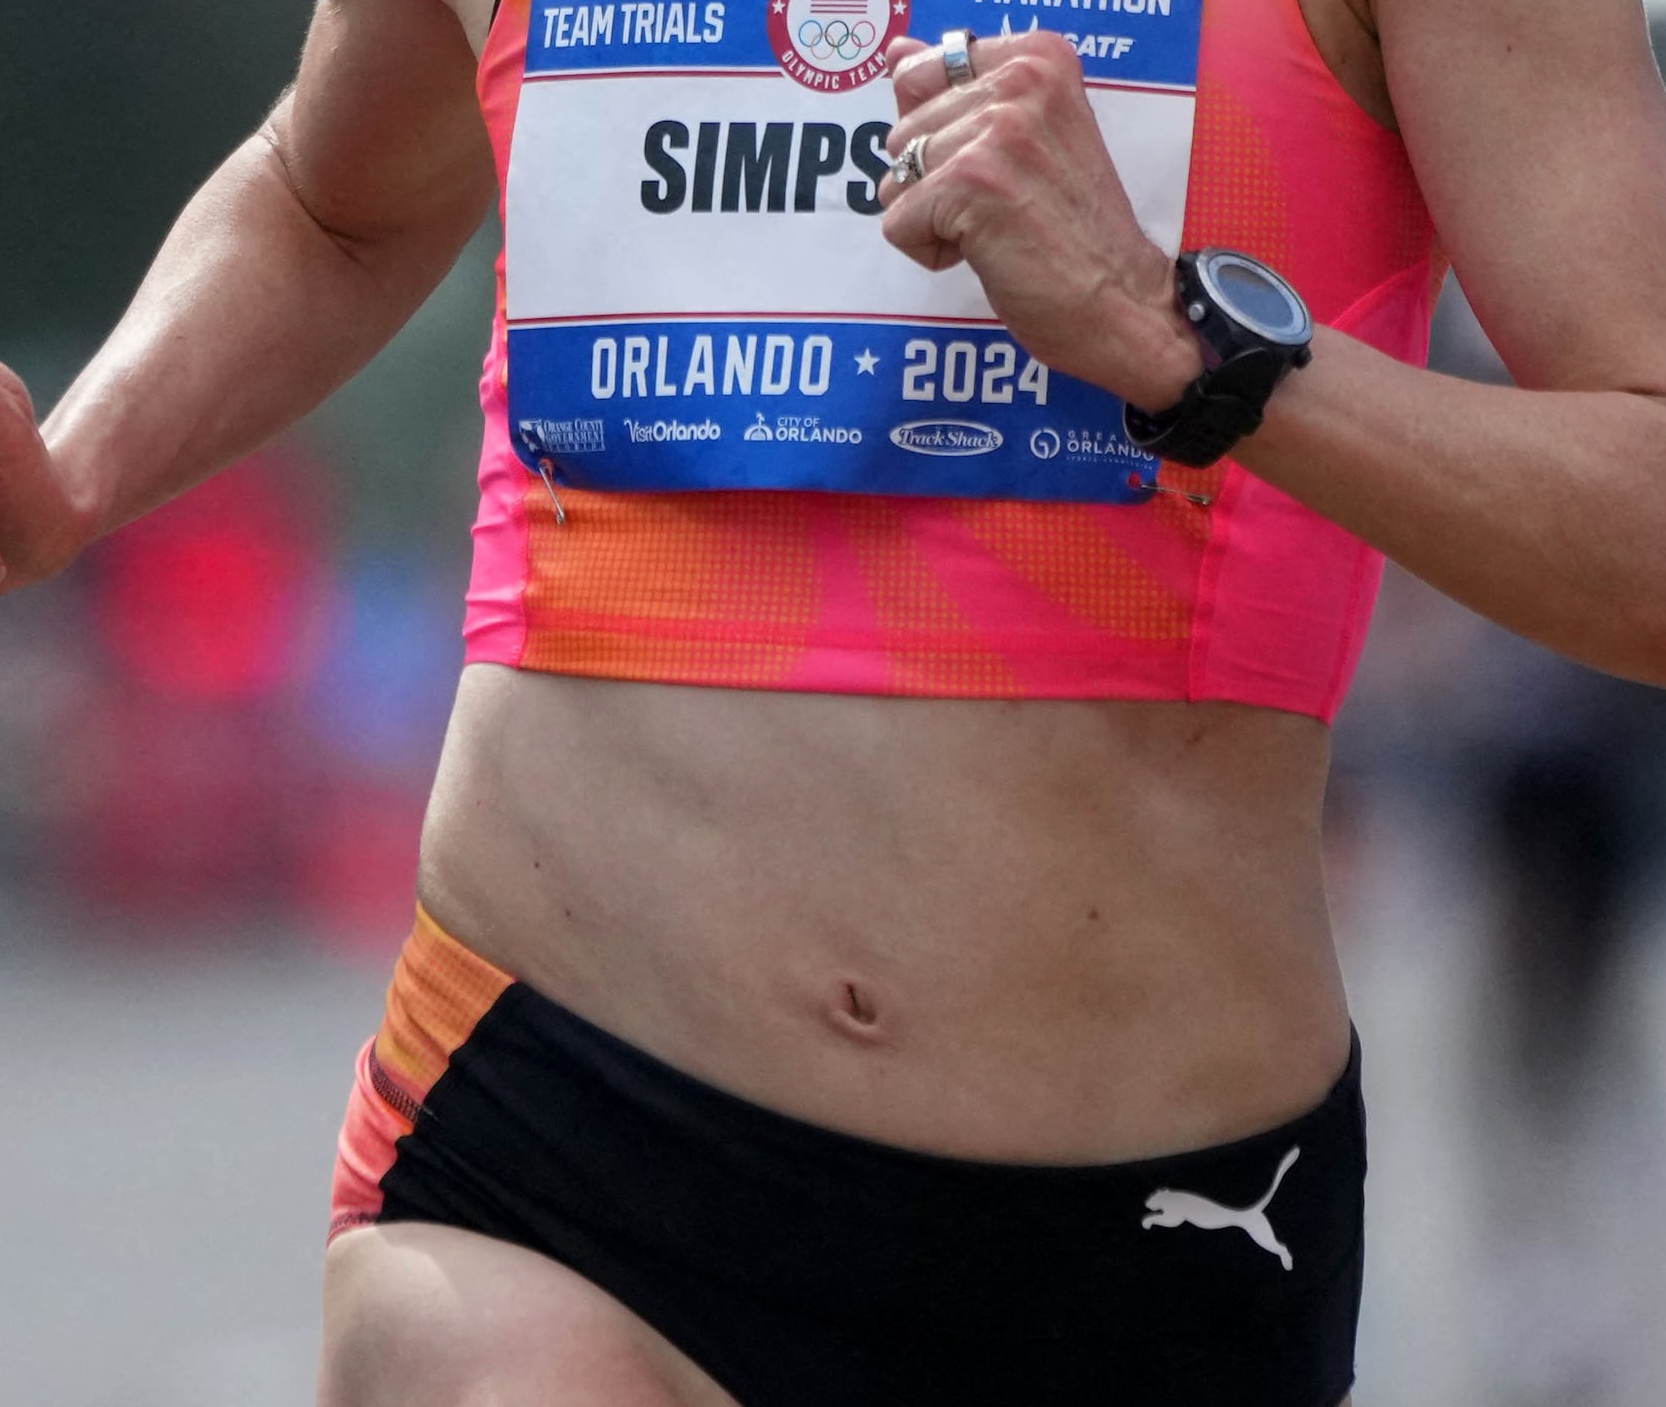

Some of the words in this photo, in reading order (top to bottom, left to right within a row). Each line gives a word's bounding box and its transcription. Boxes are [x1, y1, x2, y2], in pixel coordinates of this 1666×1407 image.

[543, 4, 615, 49] TEAM
[621, 1, 726, 44] TRIALS
[1061, 32, 1134, 60] SATF
[781, 50, 840, 90] OLYMPIC
[849, 50, 887, 86] TEAM
[640, 119, 895, 216] SIMPS
[591, 335, 833, 400] ORLANDO
[901, 339, 1049, 406] 2024
[775, 427, 863, 444] ORLANDO
[777, 417, 803, 428] CITY
[804, 417, 821, 428] OF
[900, 428, 945, 446] Track
[946, 431, 997, 448] Shack
[1067, 430, 1129, 444] GREA
